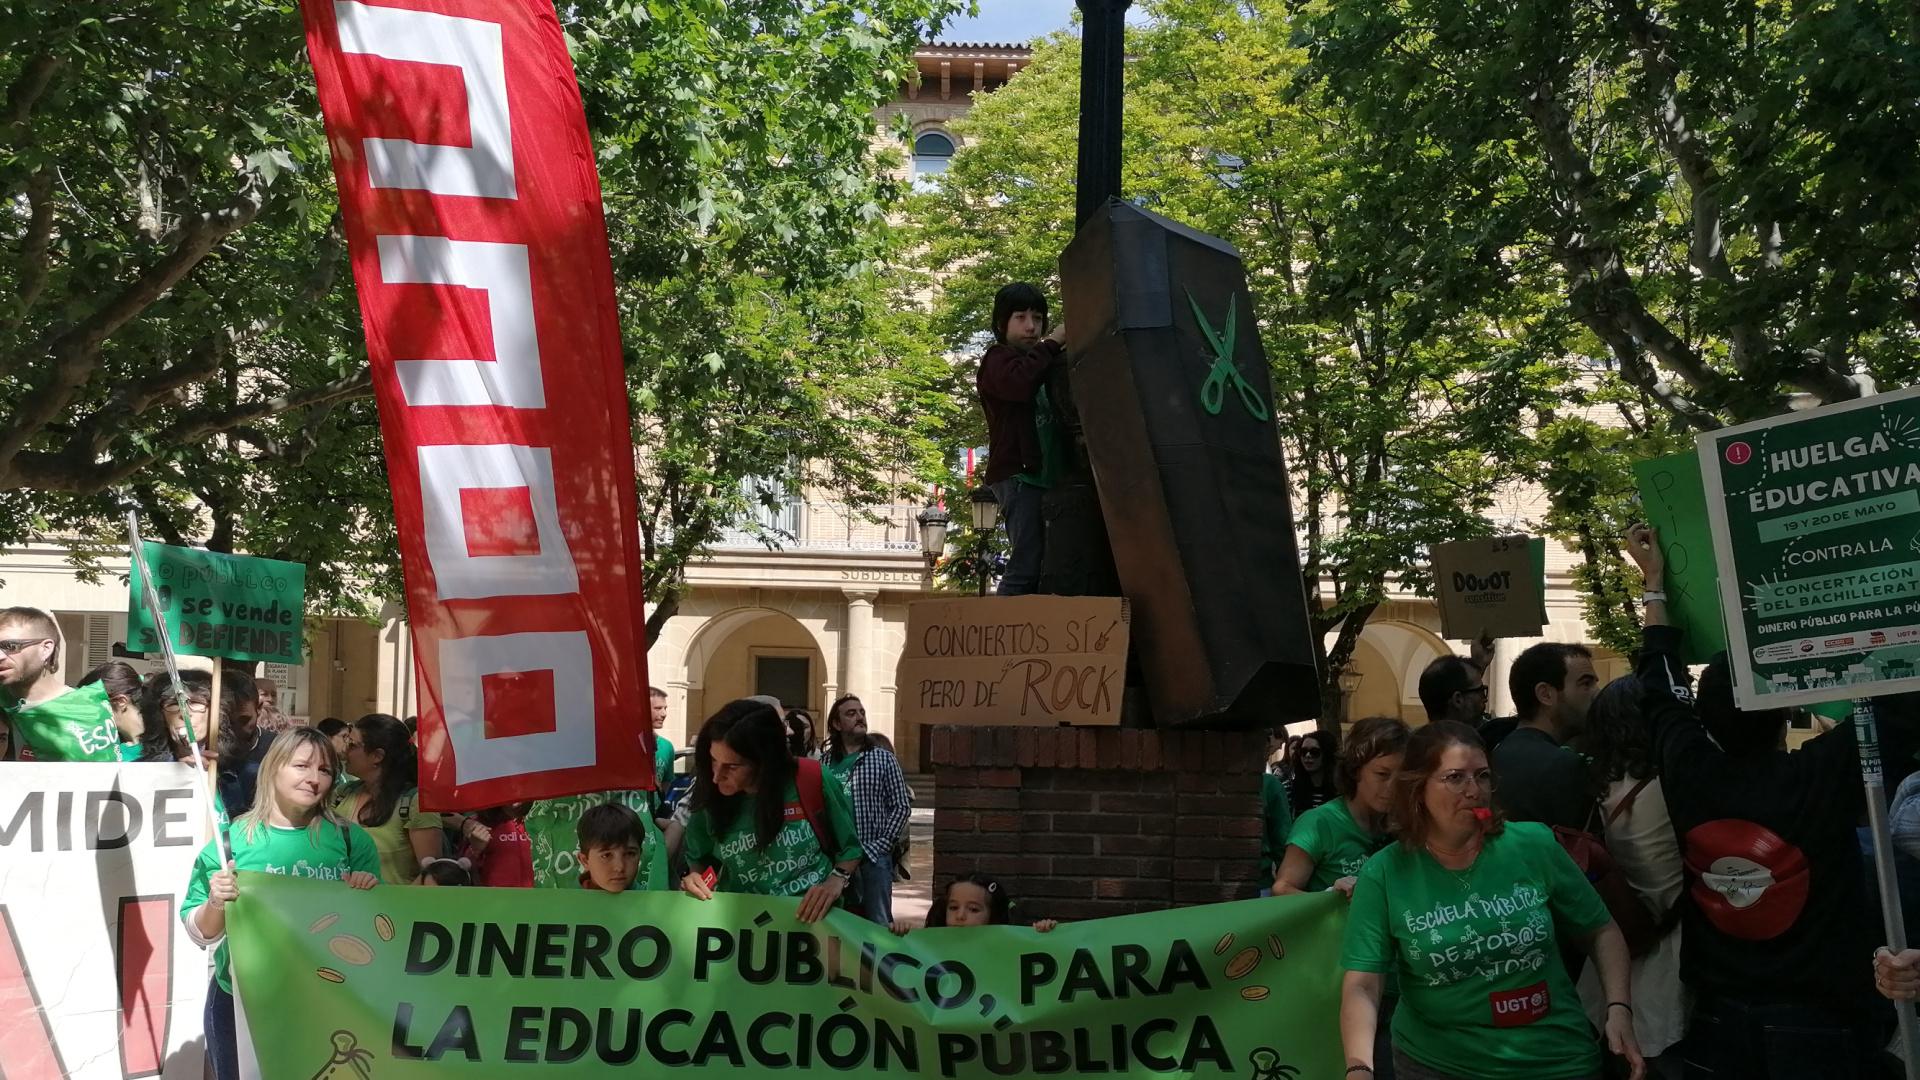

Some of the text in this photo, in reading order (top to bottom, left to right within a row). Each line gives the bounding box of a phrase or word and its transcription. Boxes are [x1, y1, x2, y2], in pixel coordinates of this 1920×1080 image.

[1770, 431, 1890, 474] HUELGA
[1749, 462, 1920, 513] EDUCATIVA
[1782, 501, 1897, 532] 19 Y 20 DE MAYO
[1787, 537, 1894, 566] CONTRA LA
[1774, 567, 1914, 597] CONCERTACIÓN
[182, 597, 214, 616] se
[222, 600, 293, 625] vende
[1757, 619, 1797, 635] DINERO
[1800, 613, 1847, 629] PÚBLICO
[1850, 607, 1883, 621] PARA
[1885, 605, 1902, 617] LA
[1763, 599, 1794, 612] DEL
[179, 620, 293, 657] DEFIENDE
[923, 615, 1097, 656] CONCIERTOS SÍ
[919, 659, 1117, 716] PERO DE ROCK
[738, 868, 758, 885] DE
[1406, 889, 1542, 933] ESCUELA PÚBLICA
[404, 911, 1212, 1018] DINERO PÚBLICO, PARA
[1429, 925, 1548, 968] DE TOD@S
[1495, 996, 1529, 1014] UGT
[391, 996, 1236, 1078] LA EDUCACIÓN PÚBLICA
